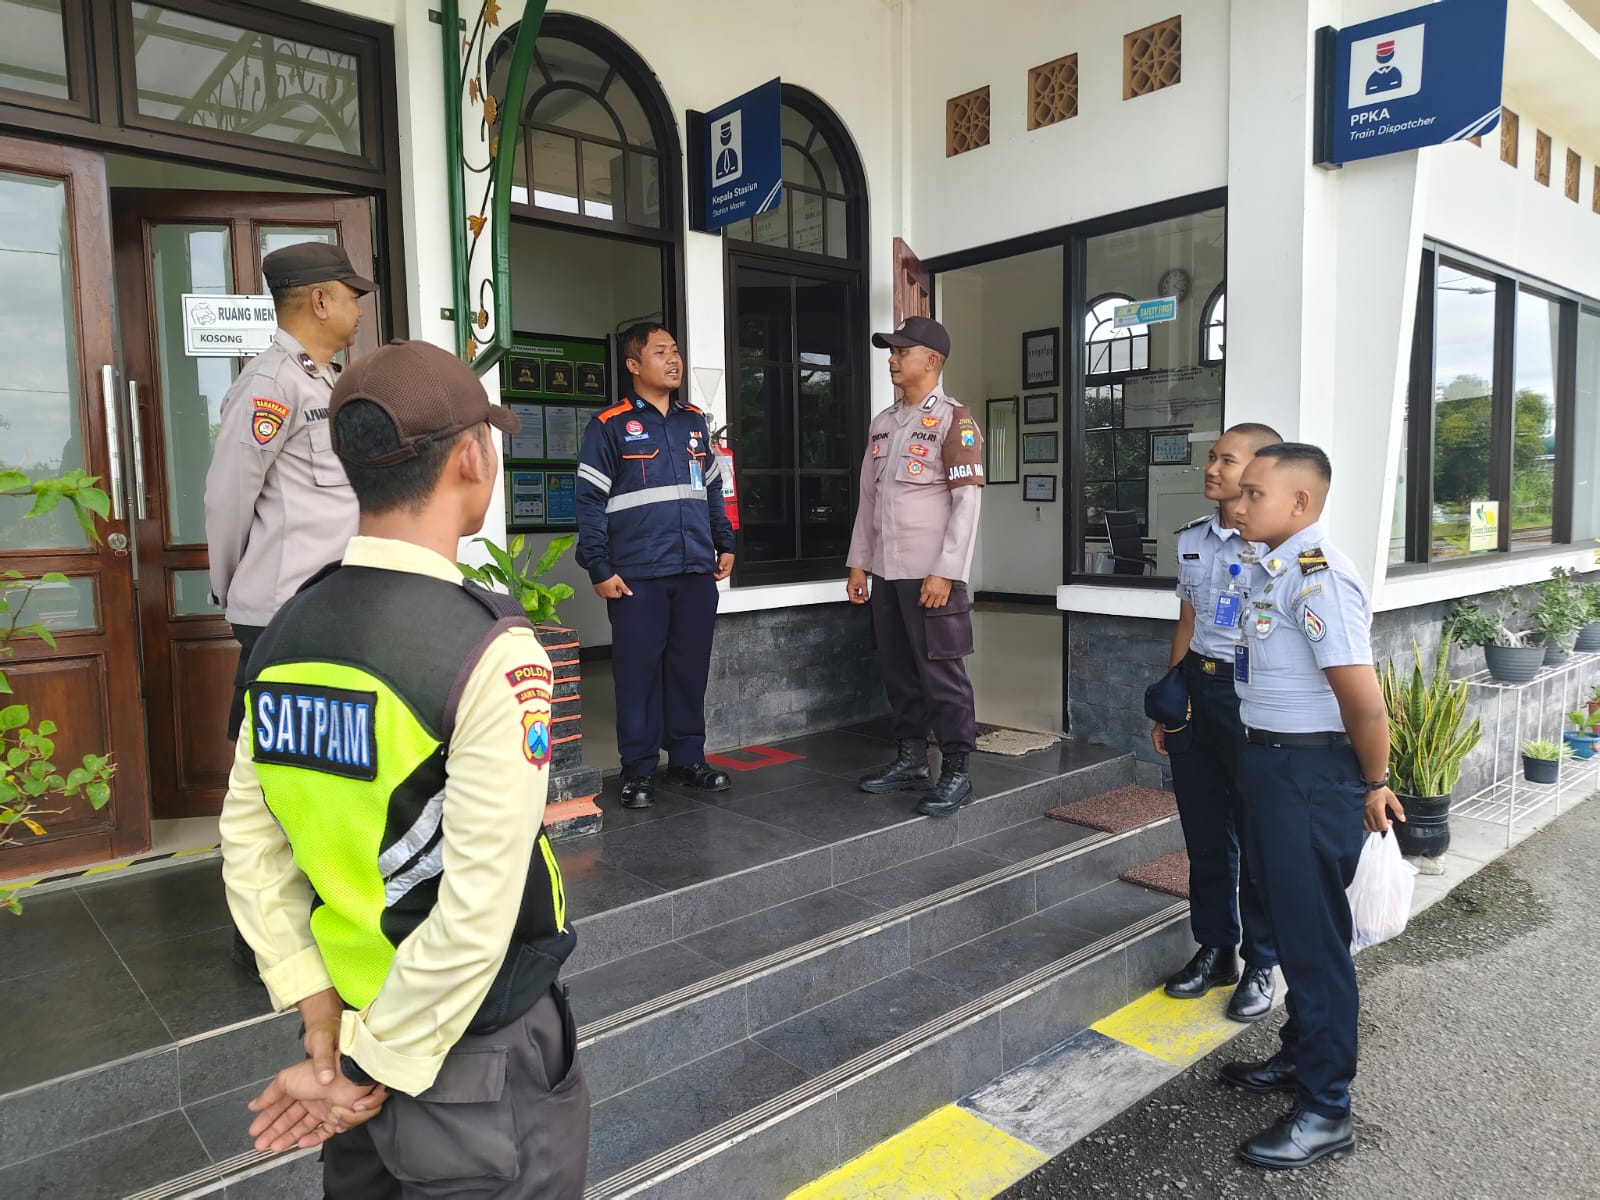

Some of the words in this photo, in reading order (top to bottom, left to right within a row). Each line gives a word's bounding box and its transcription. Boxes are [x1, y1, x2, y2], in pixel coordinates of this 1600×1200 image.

[1350, 107, 1390, 127] PPKA
[1350, 128, 1375, 141] Train
[1378, 116, 1436, 135] Dispatcher
[712, 190, 733, 205] Kepala
[734, 182, 758, 197] Stasiun
[712, 207, 729, 218] Station
[218, 307, 251, 321] RUANG
[200, 334, 243, 343] KOSONG
[911, 431, 937, 443] POLRI
[948, 464, 973, 481] JAGA
[514, 666, 548, 681] POLDA
[257, 691, 370, 767] SATPAM
